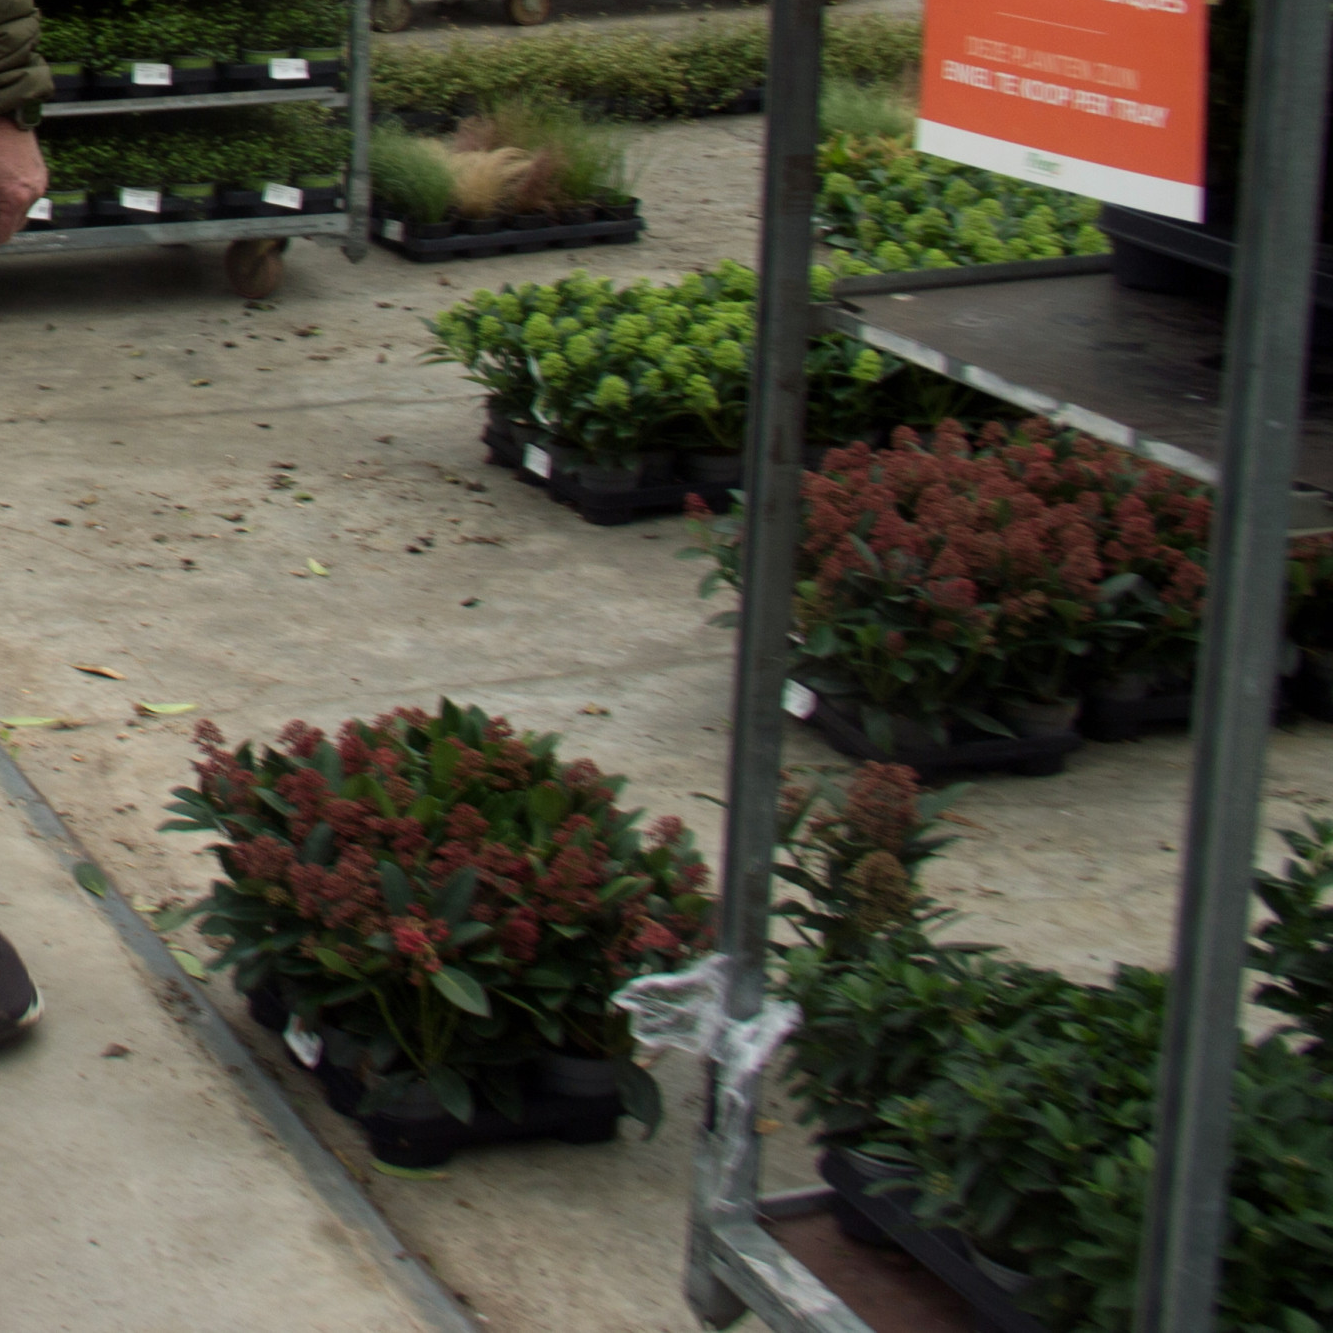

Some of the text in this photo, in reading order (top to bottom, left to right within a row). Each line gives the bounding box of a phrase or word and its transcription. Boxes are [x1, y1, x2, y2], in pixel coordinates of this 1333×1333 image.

[964, 35, 1009, 63] DEZE
[1011, 45, 1091, 79] PLANTEN
[941, 59, 1170, 129] ENKEL TE KOOP PER TRAY
